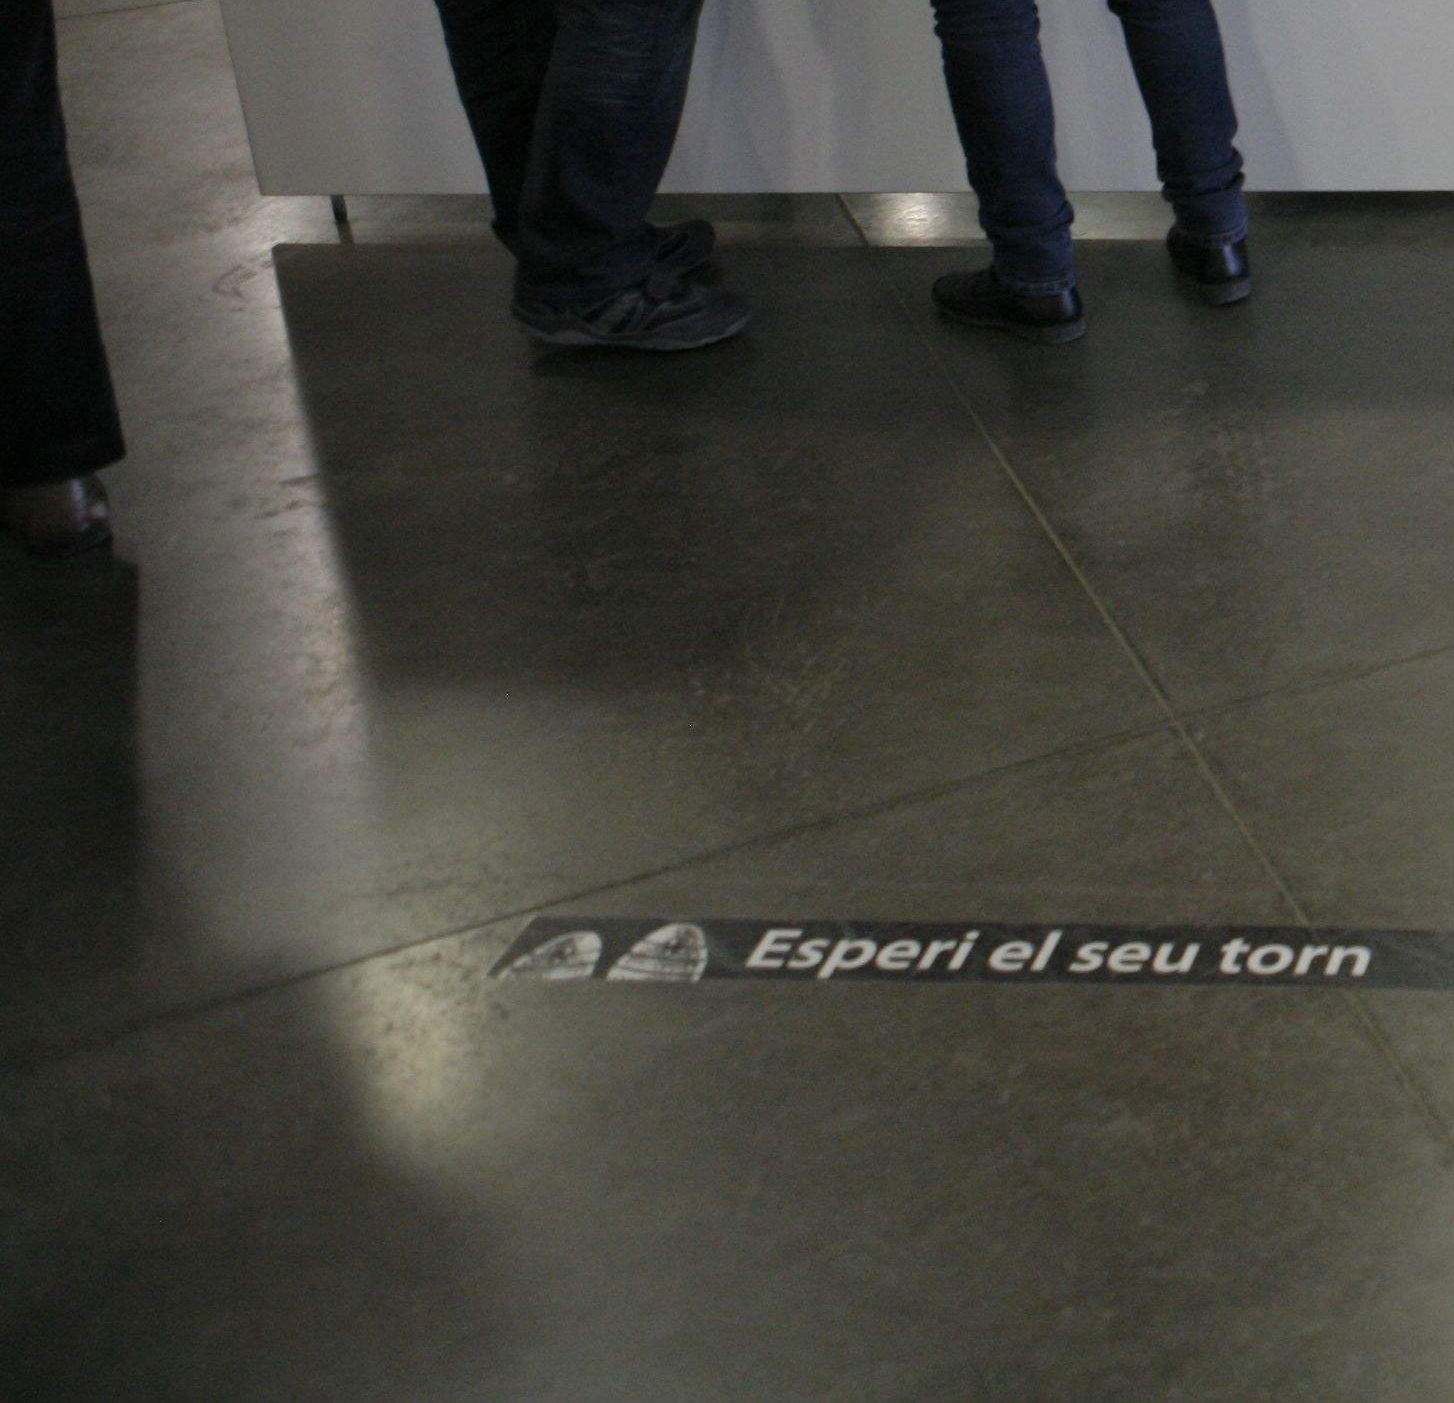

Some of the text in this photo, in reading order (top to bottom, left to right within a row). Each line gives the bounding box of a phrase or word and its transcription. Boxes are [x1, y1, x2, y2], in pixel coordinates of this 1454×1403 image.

[745, 928, 1371, 979] Esperi el seu torn
